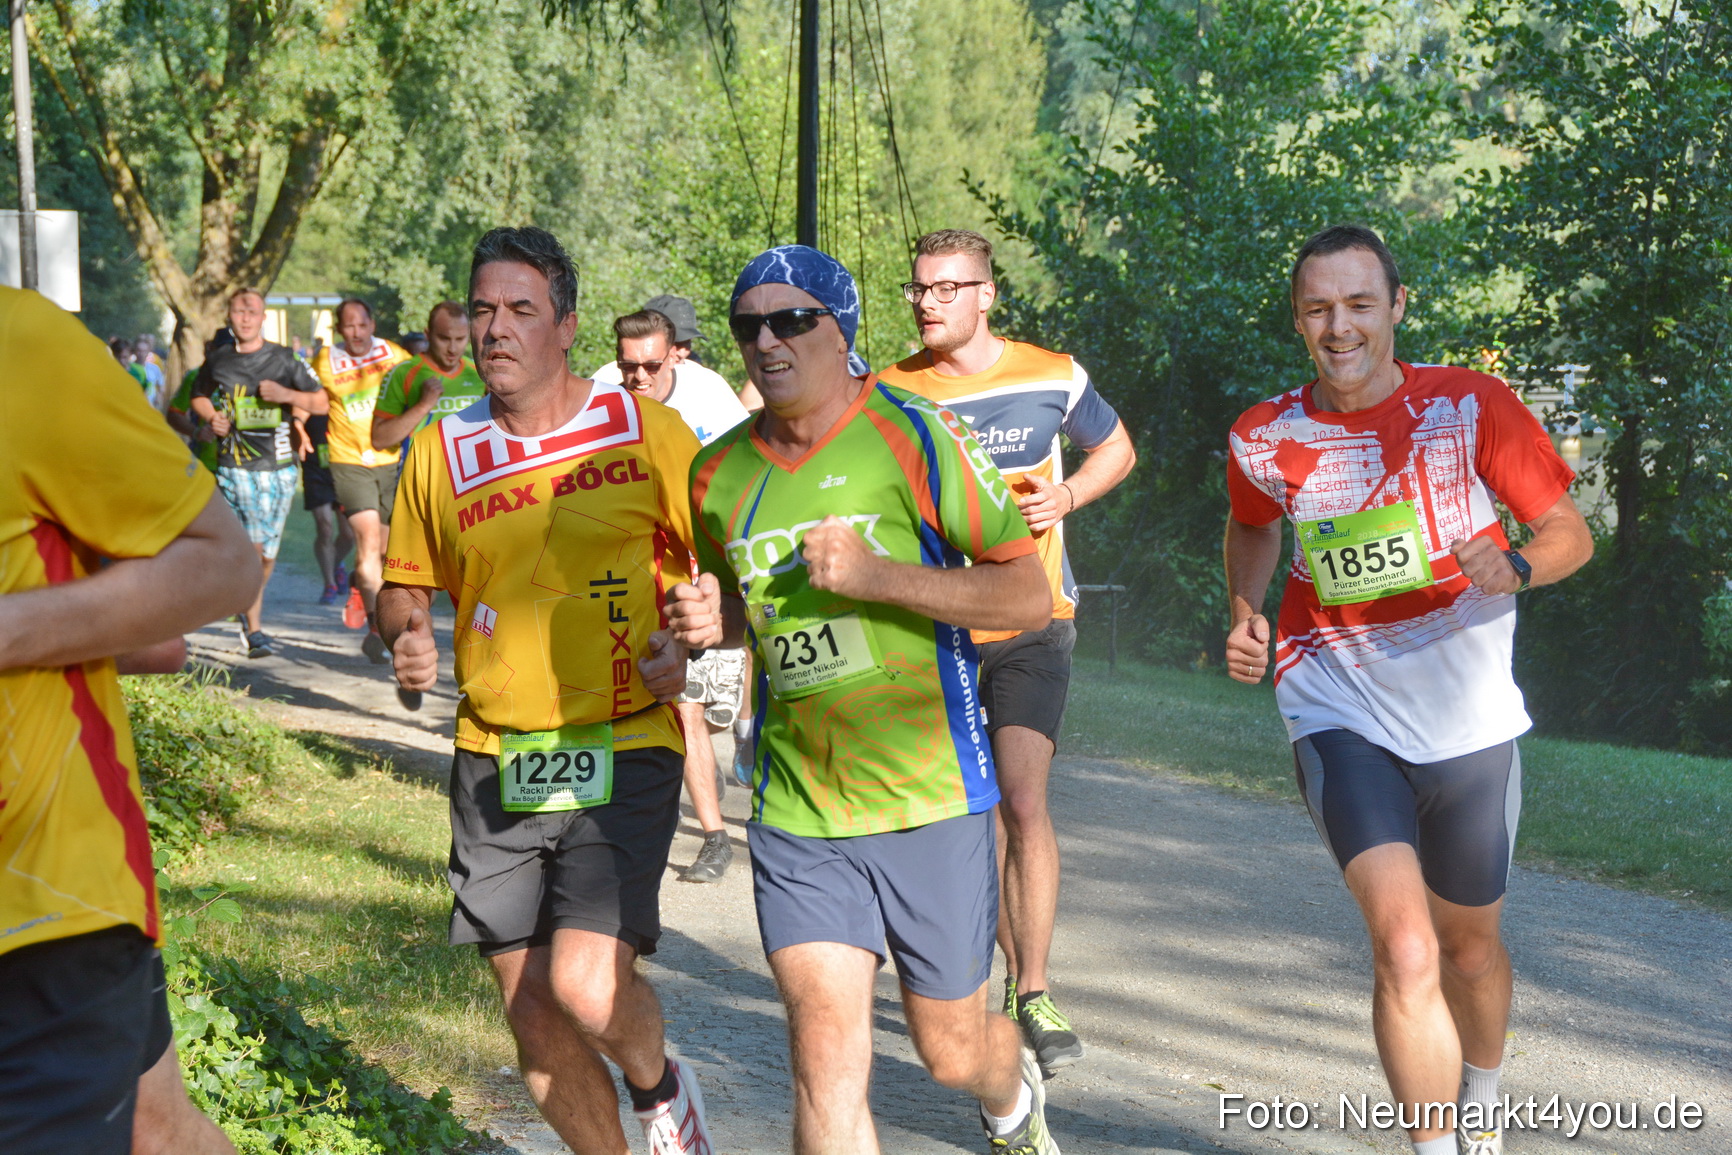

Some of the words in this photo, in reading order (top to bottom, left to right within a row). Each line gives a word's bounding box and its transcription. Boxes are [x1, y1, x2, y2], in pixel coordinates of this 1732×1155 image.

[1313, 427, 1343, 441] 10.54
[457, 482, 540, 533] MAX
[550, 458, 649, 498] BÖGL
[1315, 482, 1351, 494] 52.01
[1317, 498, 1352, 512] 26.22
[1314, 528, 1351, 541] firmenlauf
[1357, 530, 1379, 540] 2018
[1320, 536, 1410, 580] 1855
[1329, 588, 1357, 598] Sparkasse
[1358, 576, 1417, 593] Neumarkt-Parsberg
[1334, 579, 1361, 590] Pürzer
[1363, 569, 1406, 585] Bernhard
[774, 623, 840, 671] 231
[784, 669, 811, 682] Hörner
[813, 657, 848, 675] Nikolai
[795, 679, 810, 688] Bock
[817, 671, 838, 682] GmbH
[510, 751, 596, 785] 1229
[520, 786, 544, 794] Rackl
[547, 785, 583, 794] Dietmar
[522, 795, 536, 803] Bögl
